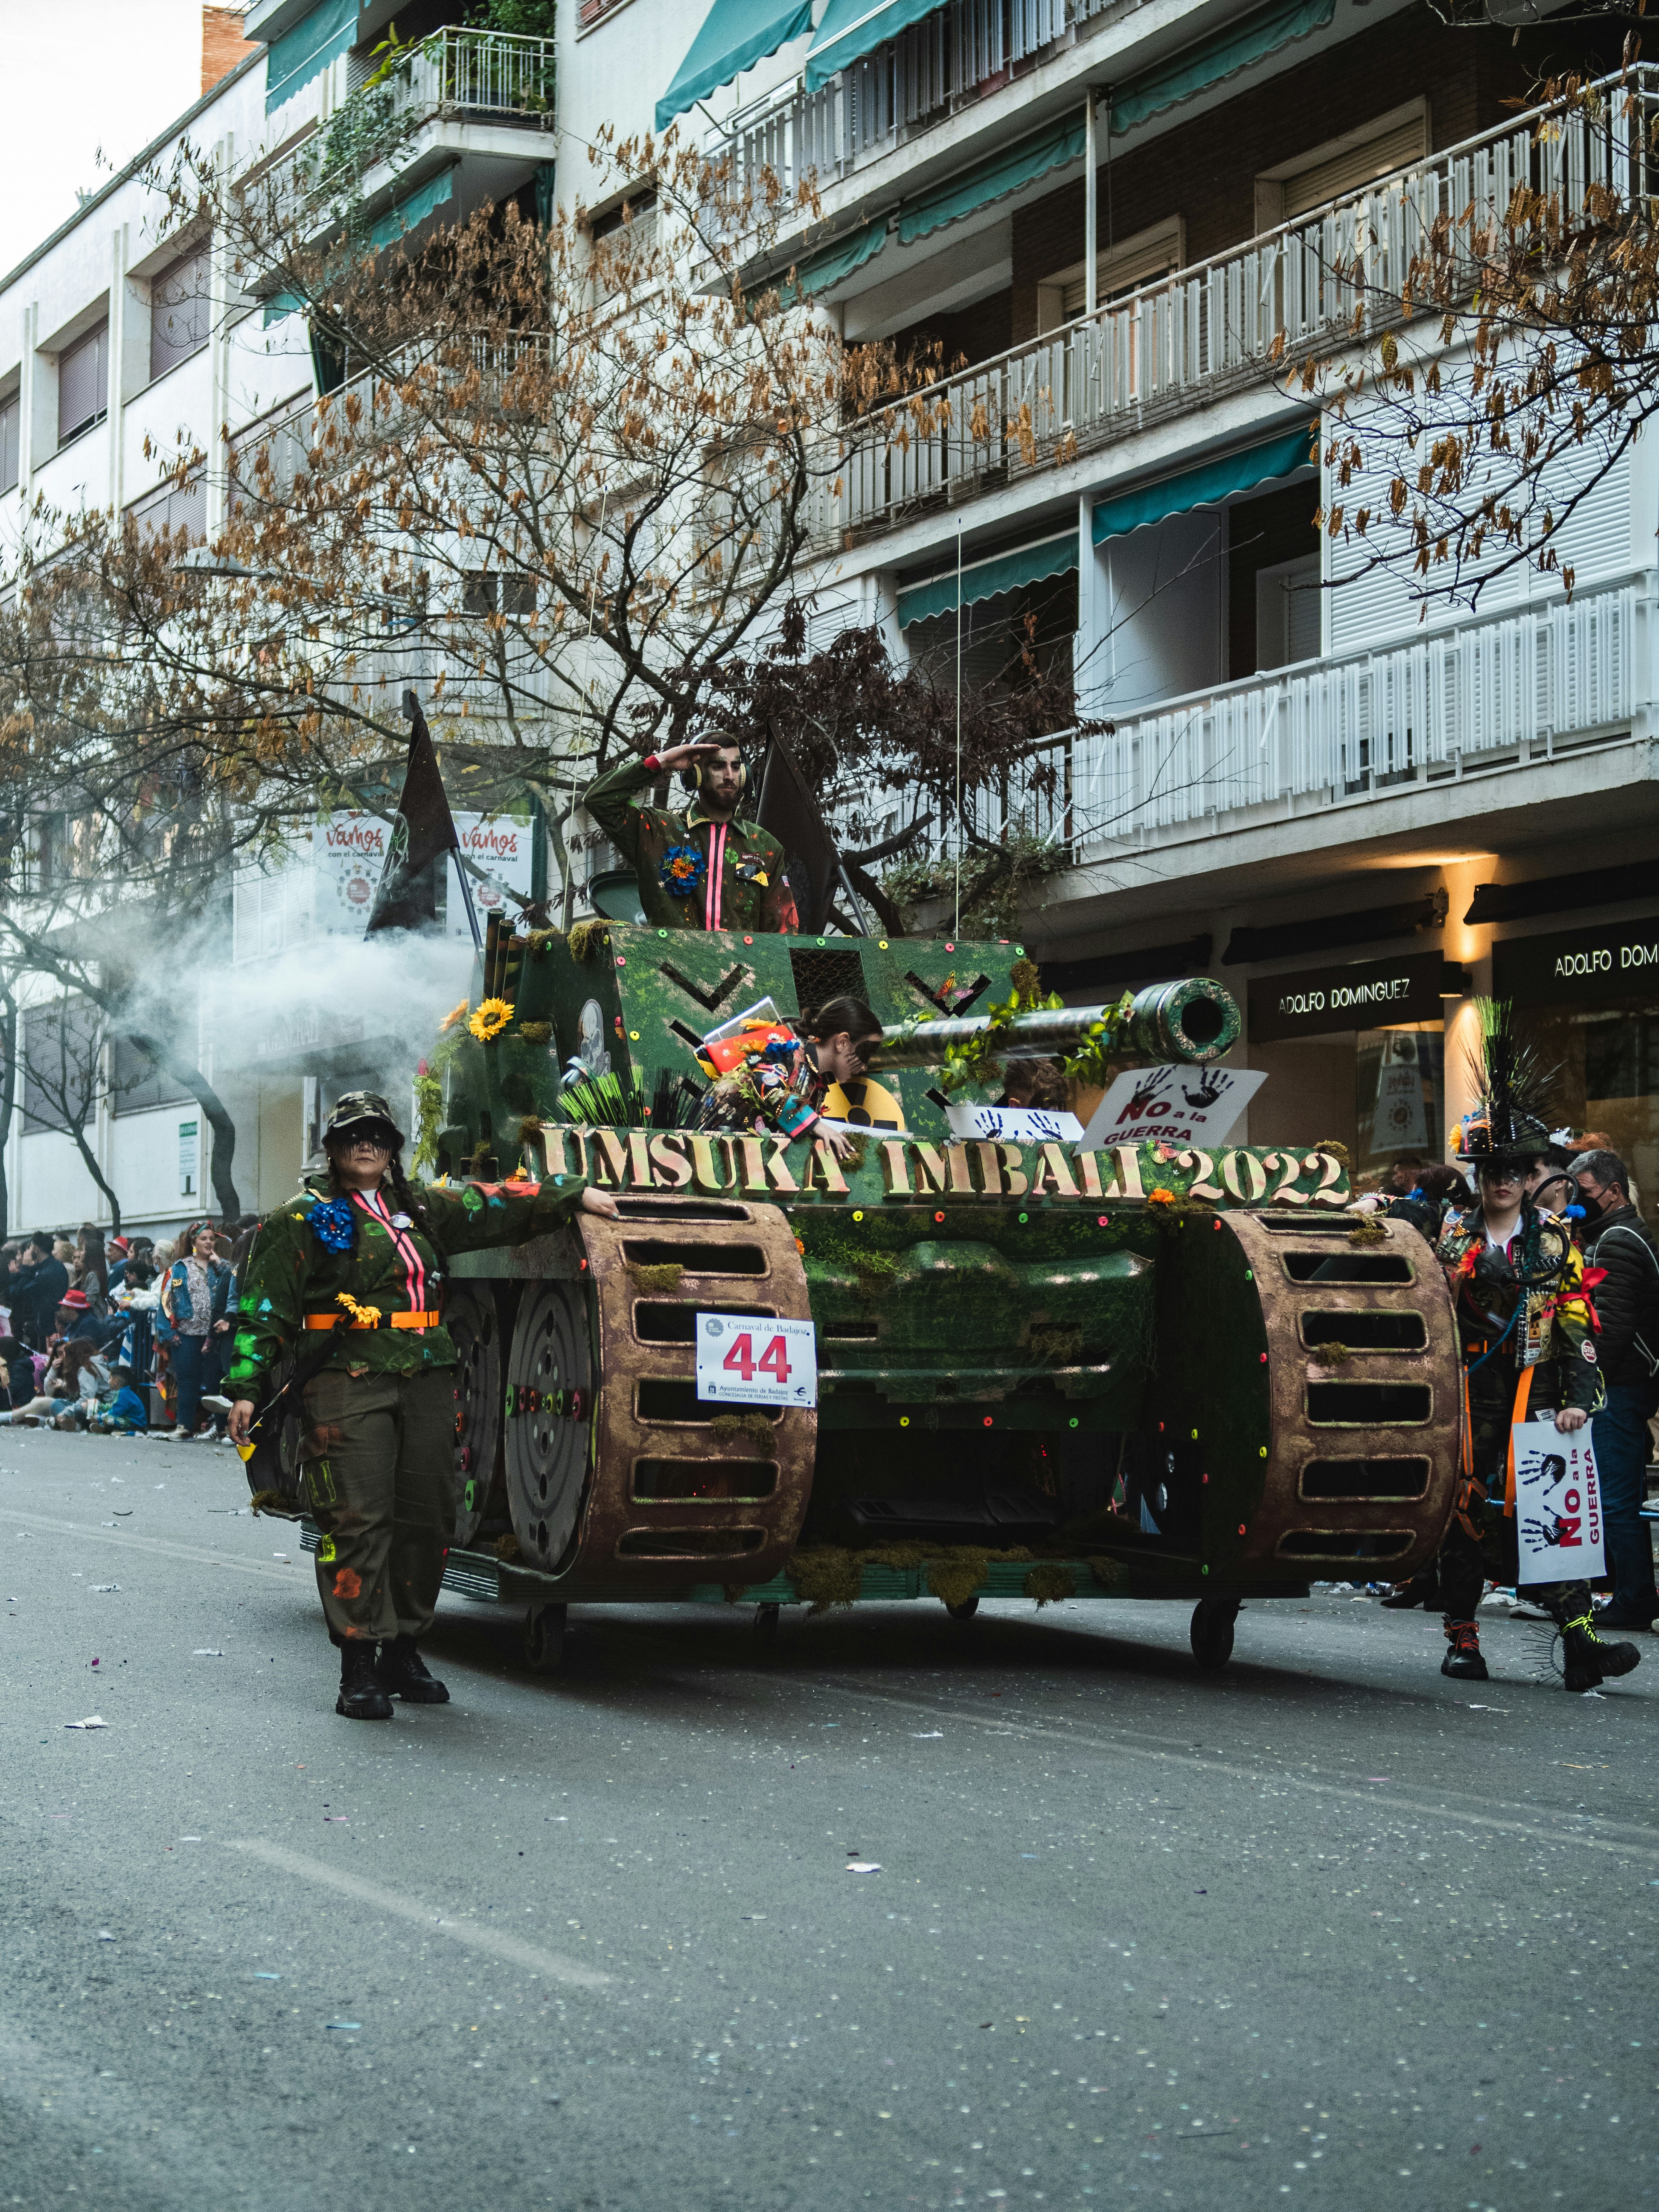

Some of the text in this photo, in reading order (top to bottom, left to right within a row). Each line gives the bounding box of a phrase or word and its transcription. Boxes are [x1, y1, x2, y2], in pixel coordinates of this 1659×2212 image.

[326, 824, 382, 852] vamos
[462, 826, 518, 856] vamos
[1554, 943, 1659, 977] ADOLFO DOM
[1279, 978, 1410, 1015] ADOLFO DOMINGUEZ
[1189, 1112, 1207, 1123] la
[1104, 1125, 1192, 1149] GUERRA
[538, 1128, 1350, 1206] UMSUKA IMBALI 2022
[728, 1321, 762, 1332] Carnaval
[777, 1325, 807, 1336] Badajoz
[723, 1333, 792, 1383] 44
[719, 1385, 758, 1394] Ayuntamiento
[1570, 1449, 1578, 1464] la
[1573, 1471, 1579, 1481] a
[1584, 1448, 1600, 1544] GUERRA
